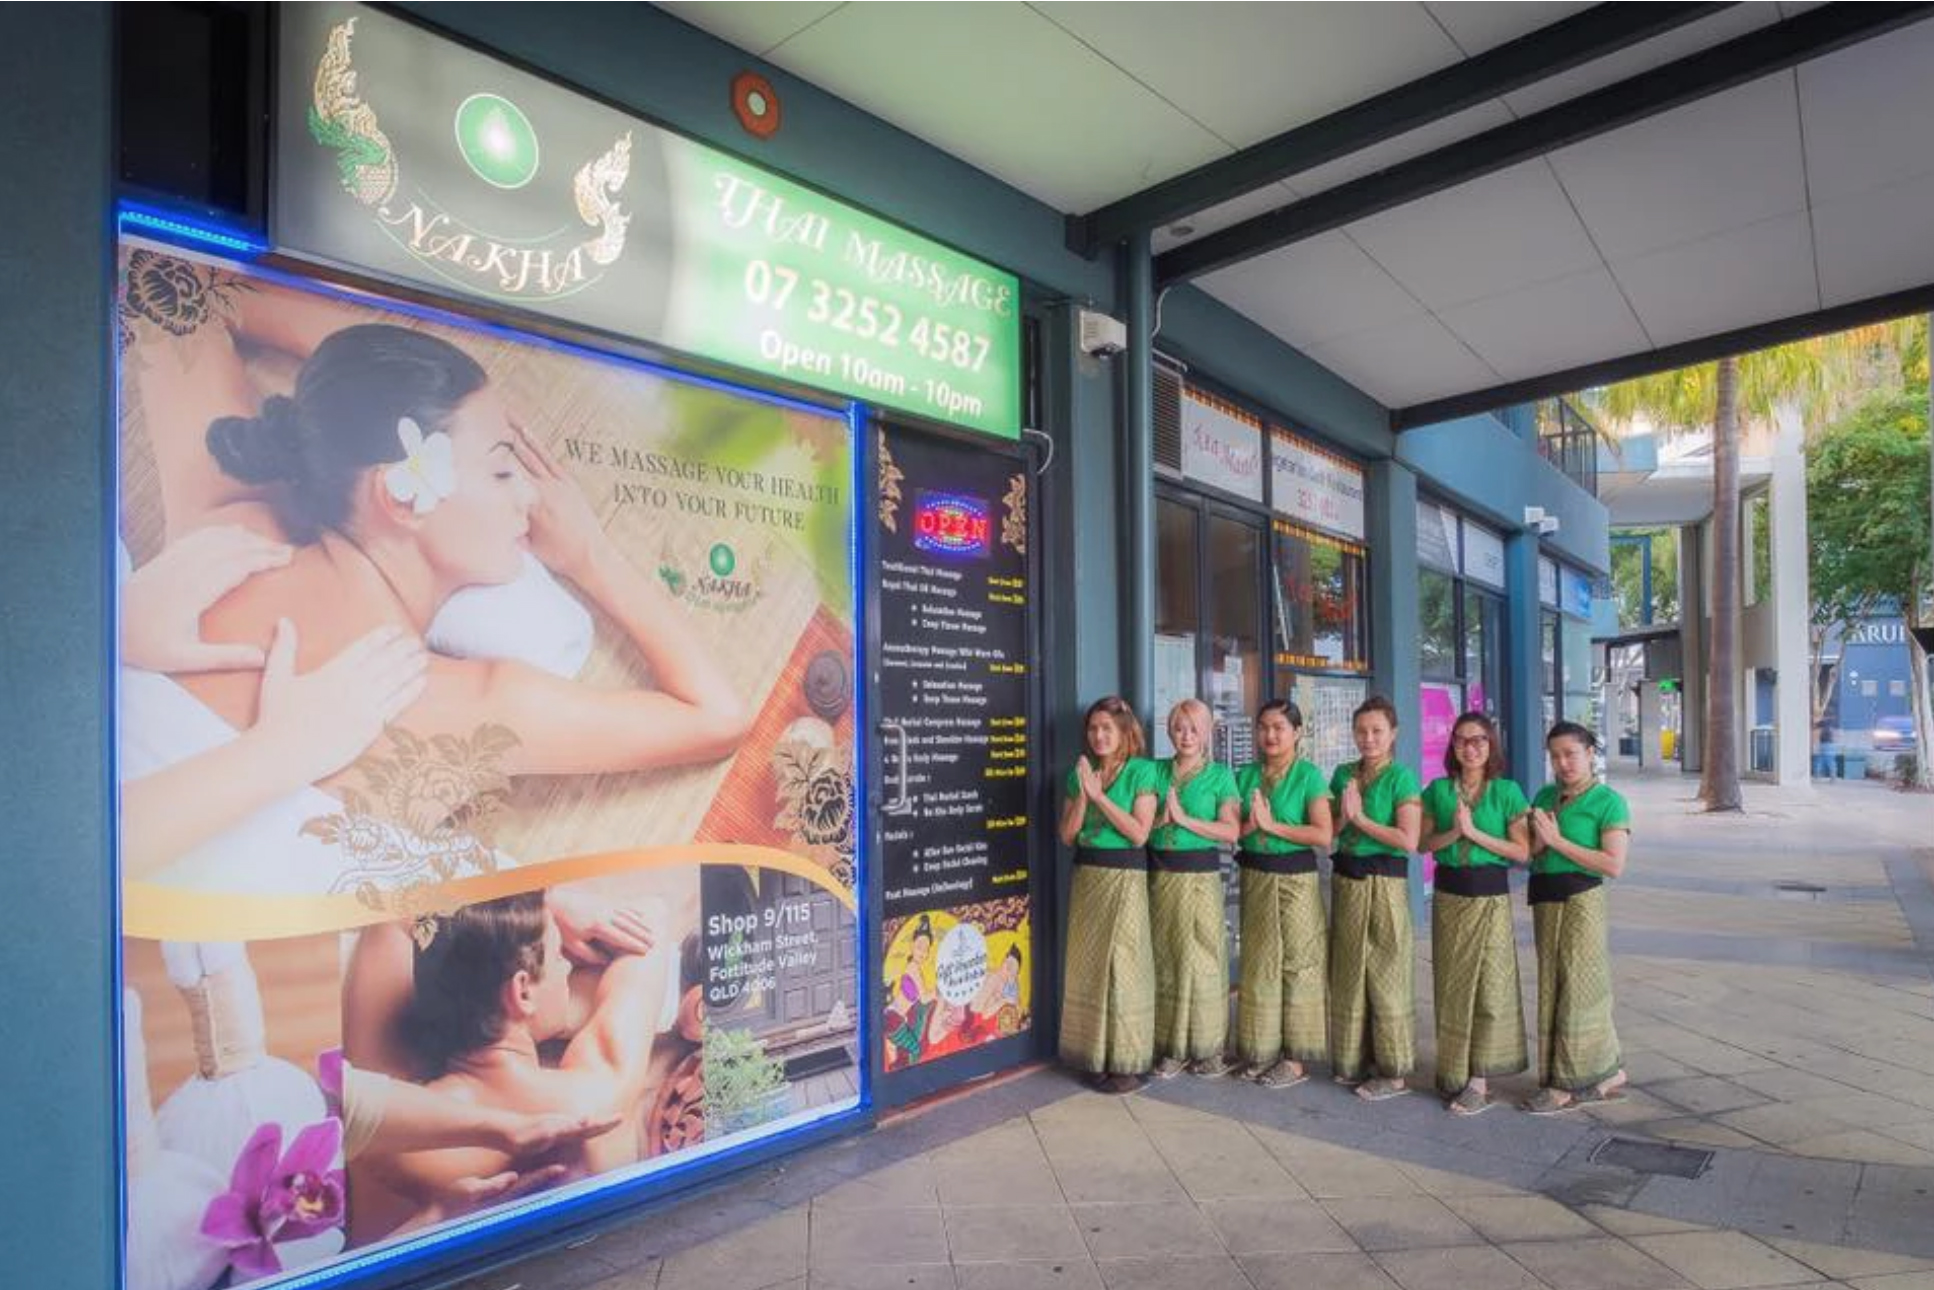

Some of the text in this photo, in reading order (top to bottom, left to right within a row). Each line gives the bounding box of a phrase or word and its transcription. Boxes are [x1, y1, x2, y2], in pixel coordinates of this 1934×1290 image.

[377, 202, 586, 294] NAKHA
[714, 172, 1013, 317] THAI MASSAGE
[744, 259, 992, 373] 07 3252 4587
[759, 329, 832, 376] Open
[840, 353, 906, 397] 10am
[924, 379, 983, 417] 10pm
[565, 438, 841, 506] WE MASSAGE YOUR HEALTH
[614, 484, 805, 532] INTO YOUR FUTURE
[920, 511, 987, 541] OPEN
[708, 902, 811, 935] Shop 9/115
[708, 931, 818, 961] Wickham Street,
[709, 950, 817, 982] Fortitude Valley
[709, 976, 776, 1001] QLD 4006
